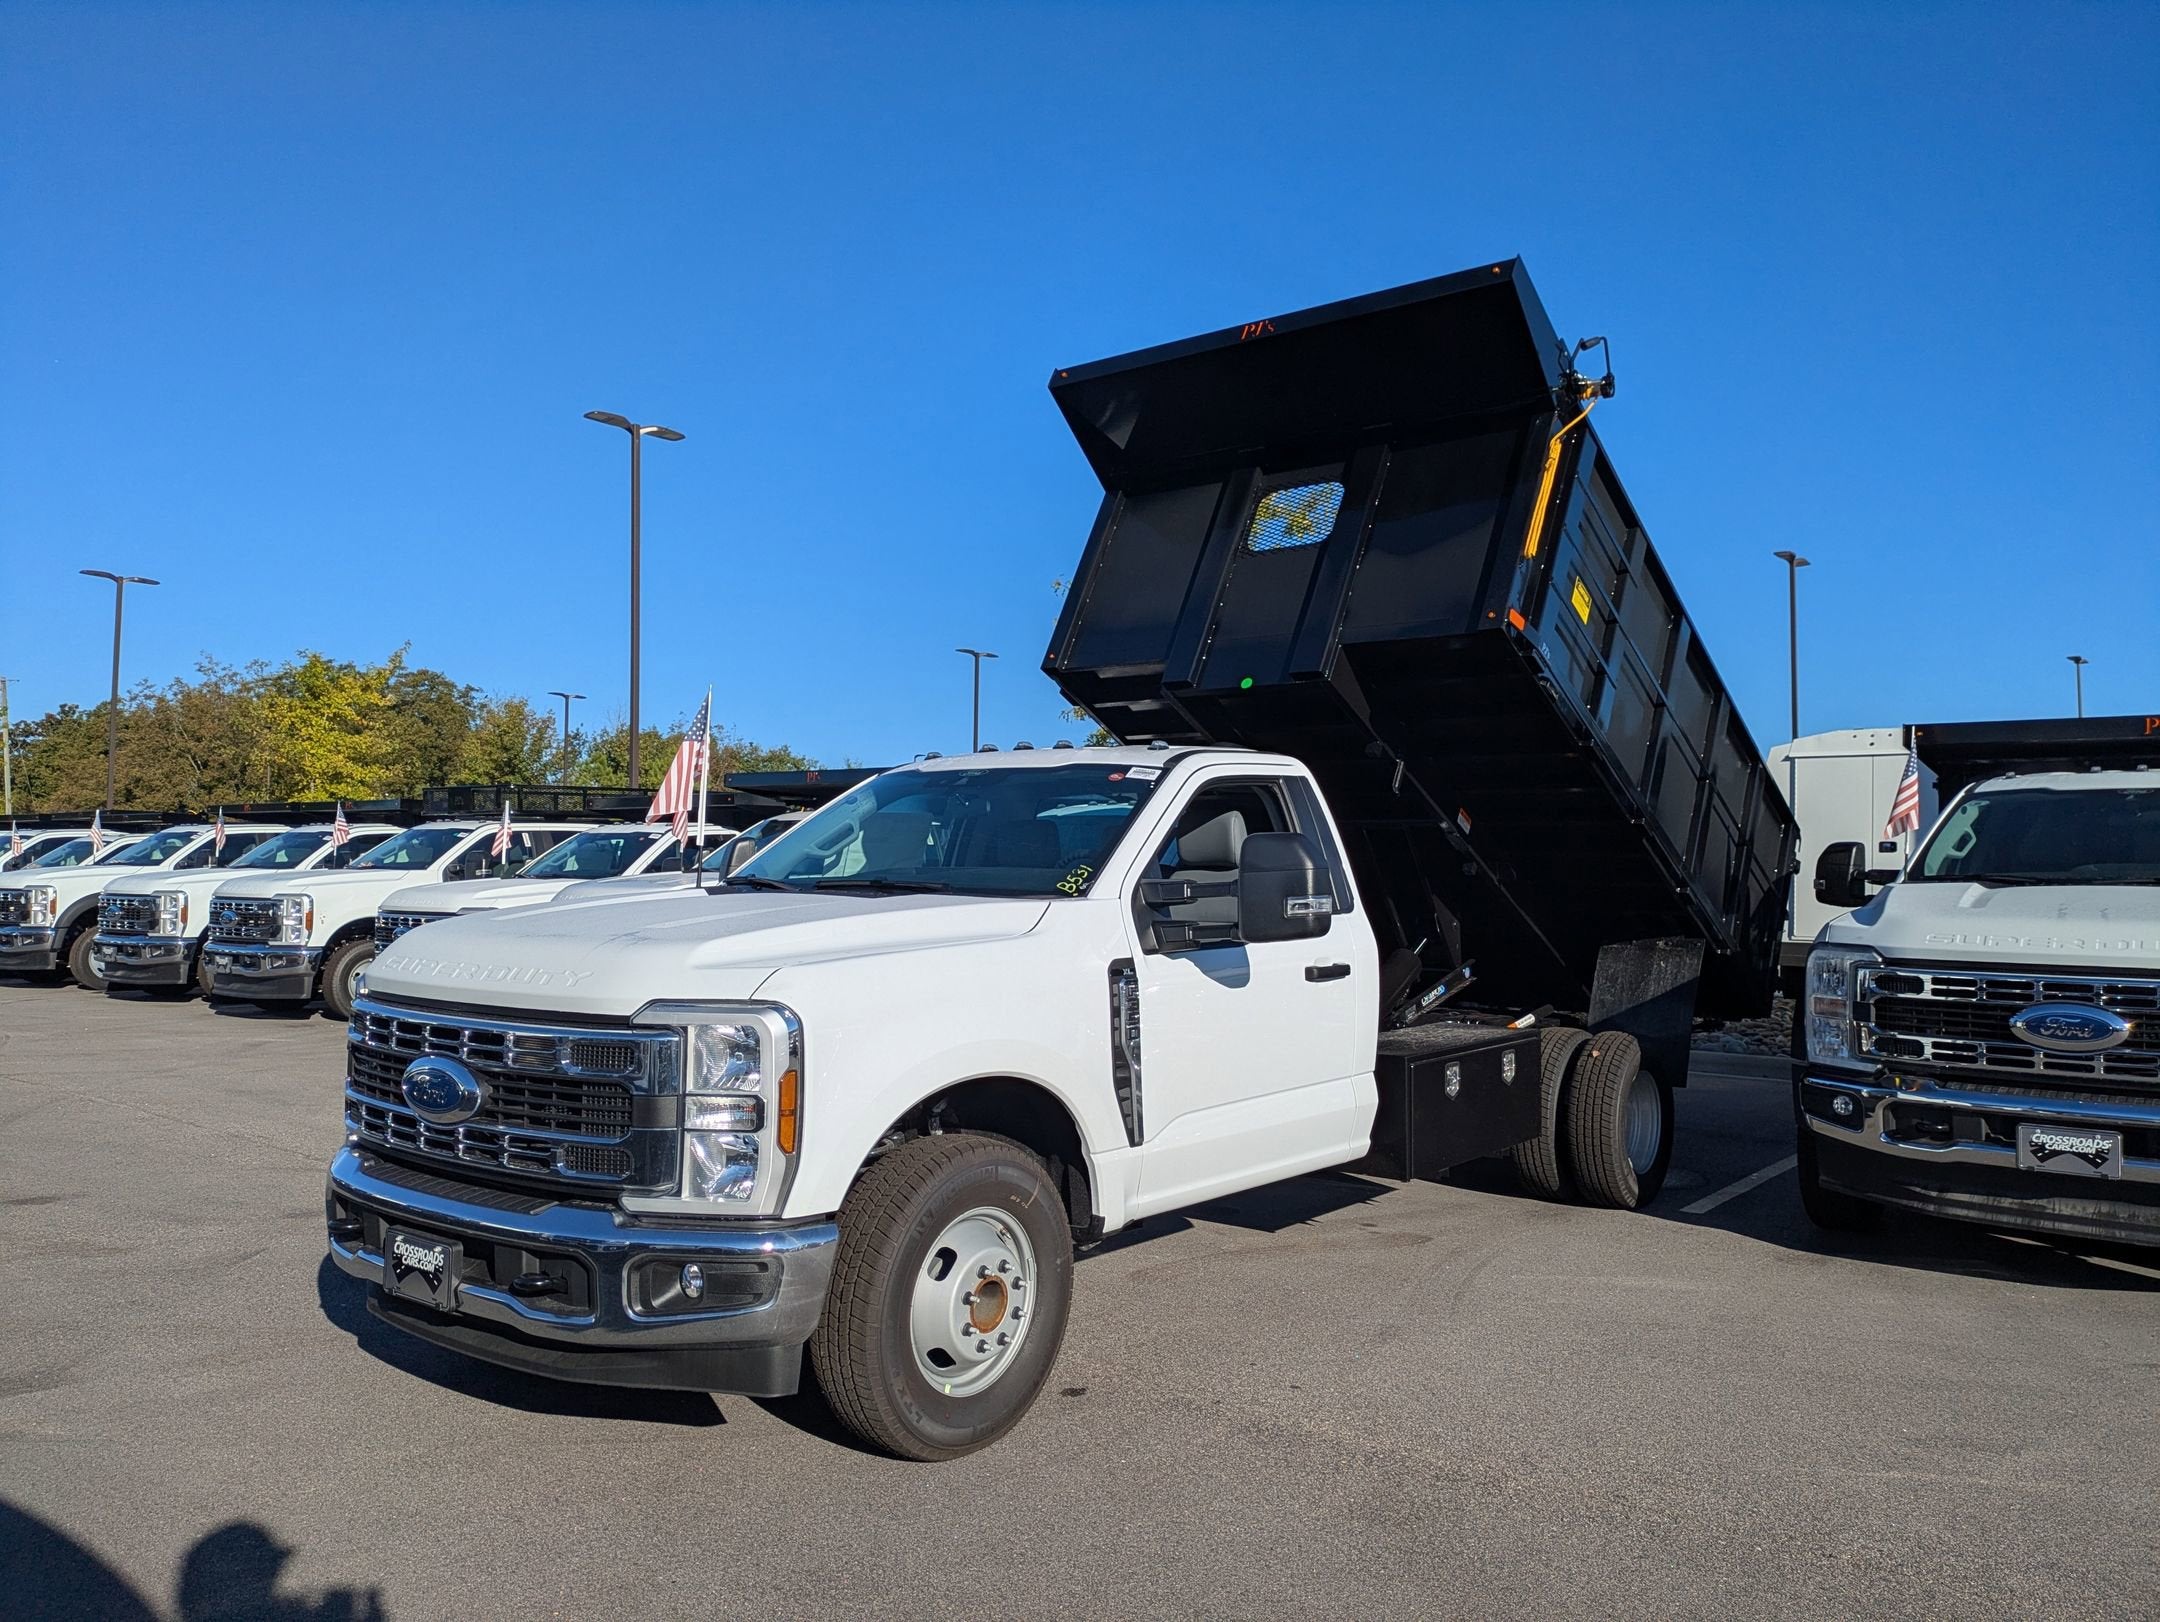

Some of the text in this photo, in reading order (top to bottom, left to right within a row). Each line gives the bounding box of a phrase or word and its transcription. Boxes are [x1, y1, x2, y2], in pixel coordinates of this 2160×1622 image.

[1056, 864, 1094, 893] B531
[1925, 933, 2086, 950] SUPER
[382, 955, 595, 988] SUPER DUTY
[2040, 1016, 2096, 1039] Ford
[412, 1073, 450, 1105] Ford
[2031, 1133, 2110, 1150] CROSSROADS
[2045, 1143, 2096, 1155] CARS.COM
[394, 1242, 445, 1267] CROSSROADS
[402, 1256, 435, 1273] CARS.COM
